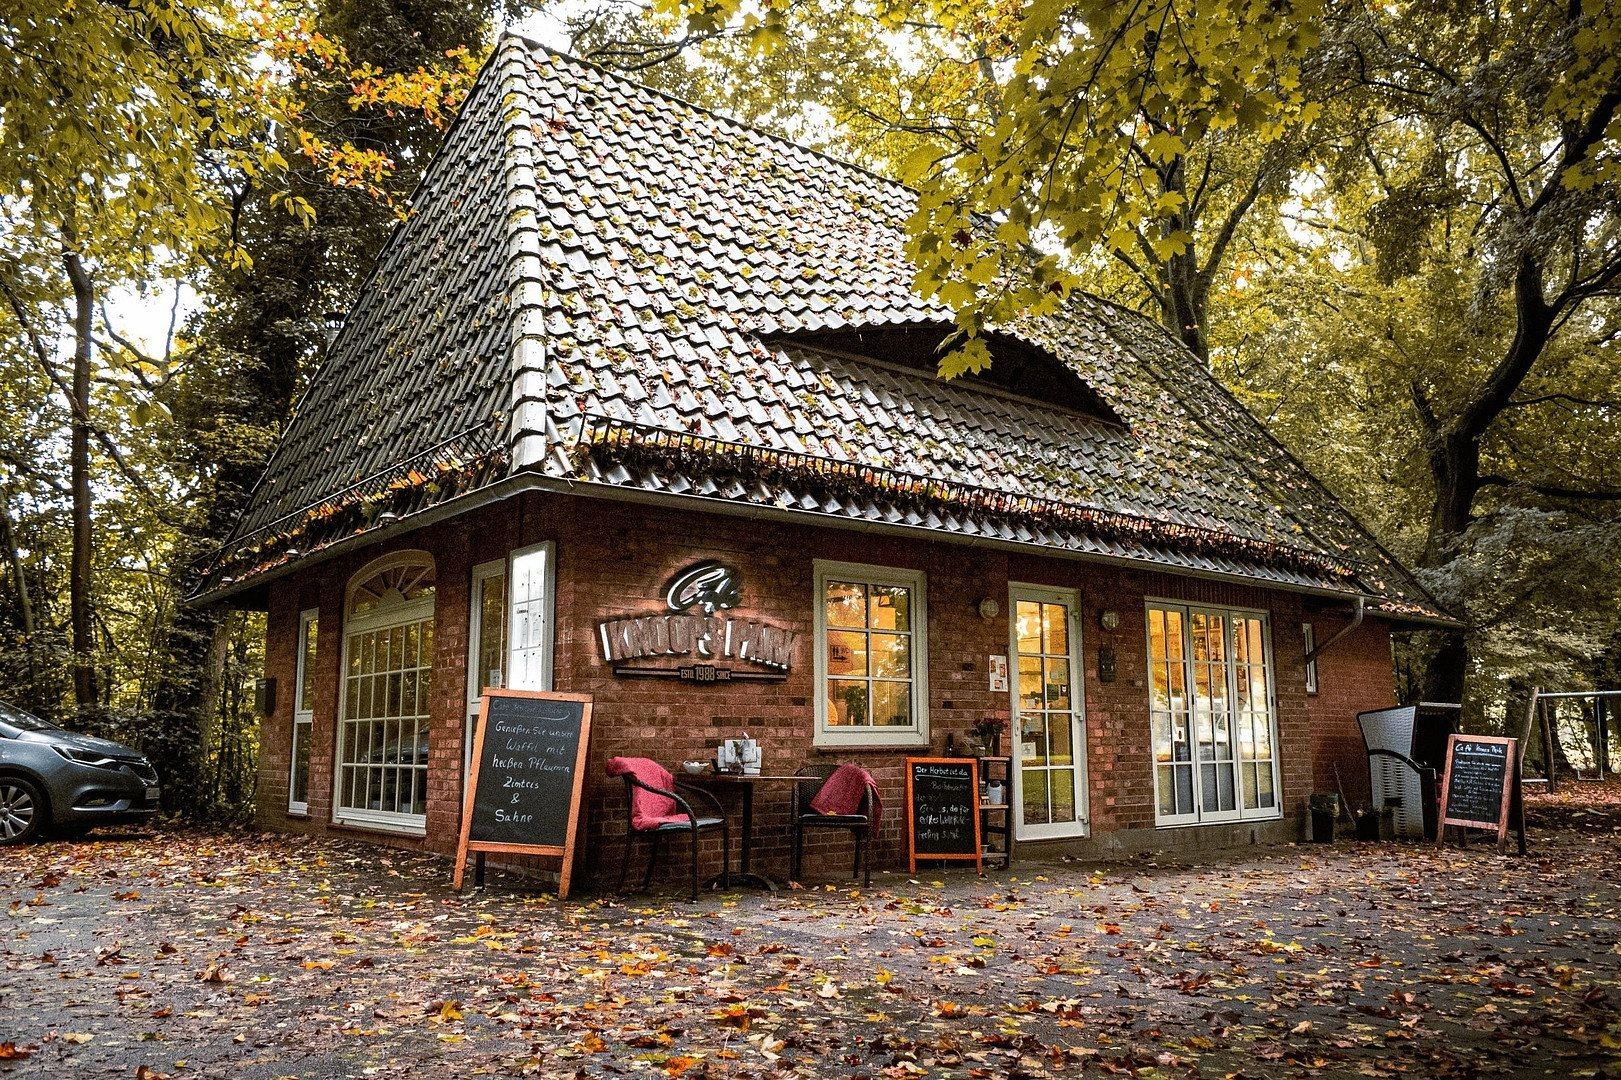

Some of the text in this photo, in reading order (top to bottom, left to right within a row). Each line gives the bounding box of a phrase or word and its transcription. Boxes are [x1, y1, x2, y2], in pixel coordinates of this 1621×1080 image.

[695, 666, 715, 680] 1988
[716, 670, 731, 680] SINCE
[546, 745, 565, 755] mit
[492, 753, 523, 770] heißen
[915, 766, 927, 774] Der
[503, 775, 539, 789] Zimteis
[510, 792, 520, 804] &
[495, 808, 533, 823] Sahne
